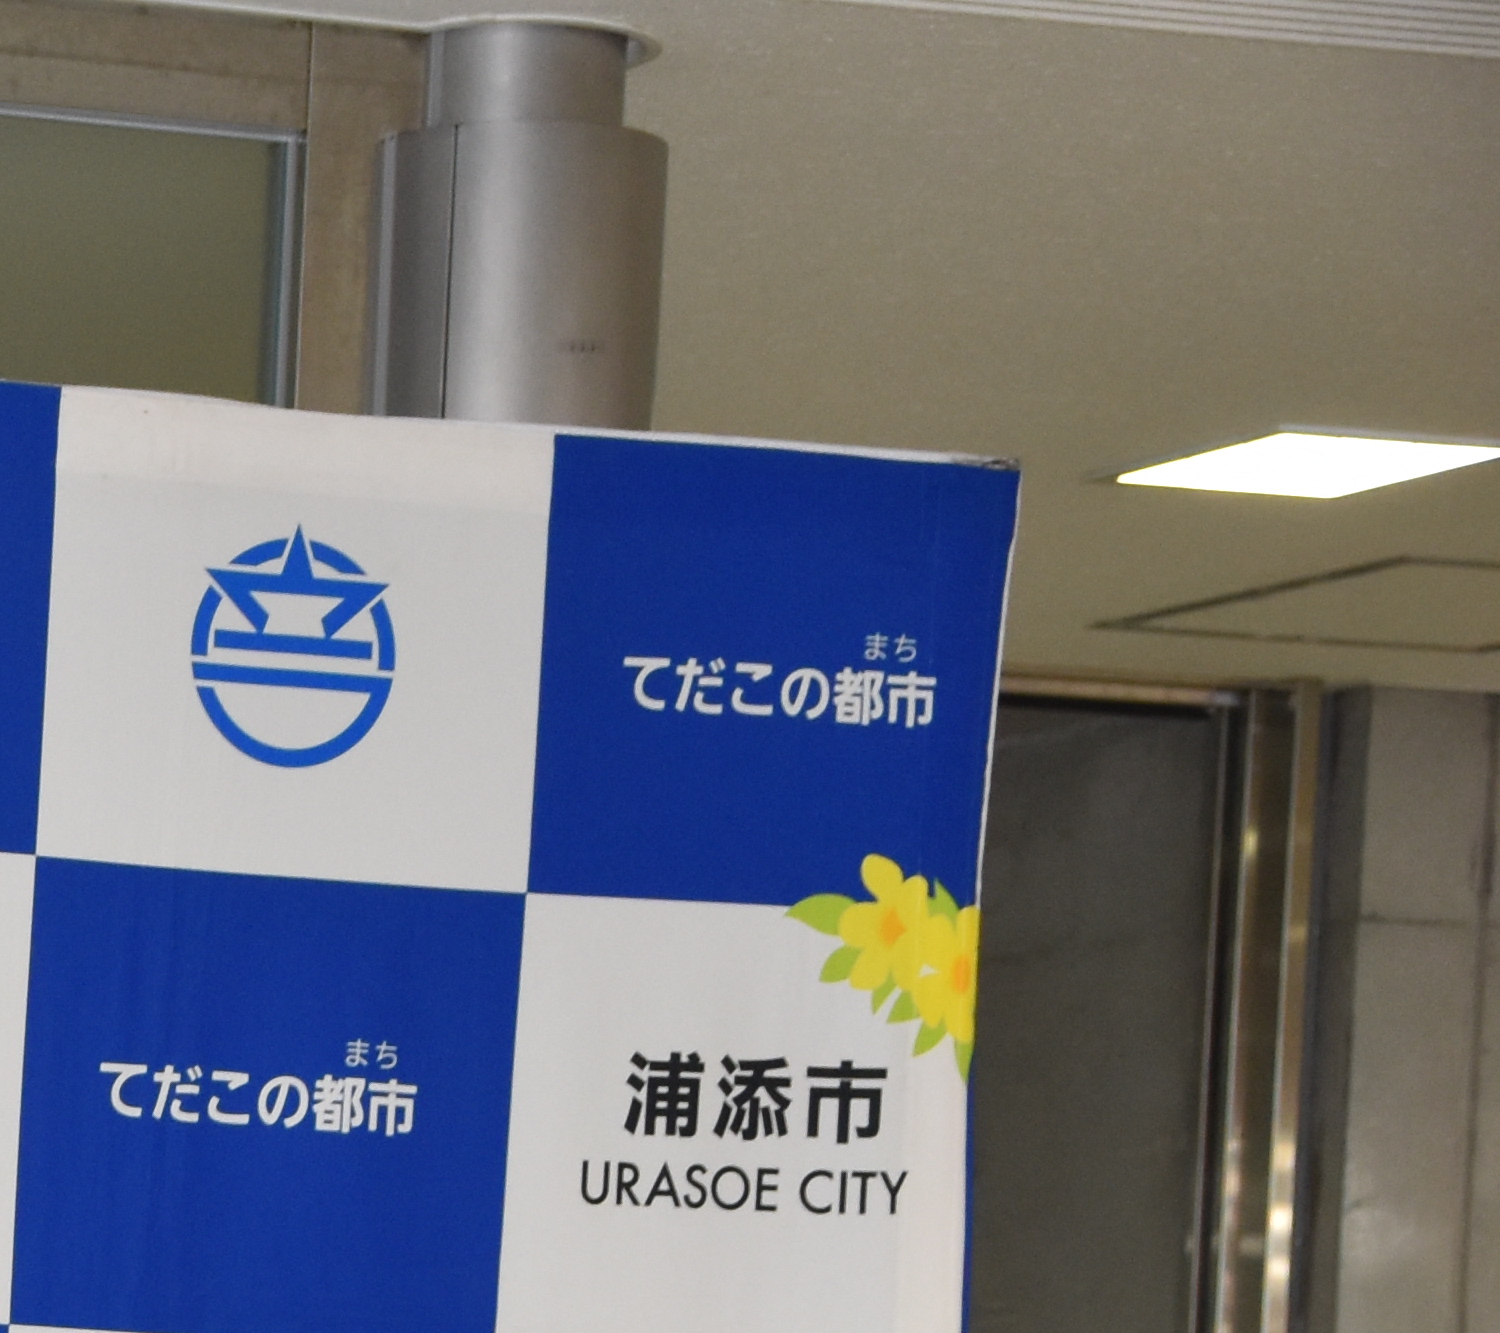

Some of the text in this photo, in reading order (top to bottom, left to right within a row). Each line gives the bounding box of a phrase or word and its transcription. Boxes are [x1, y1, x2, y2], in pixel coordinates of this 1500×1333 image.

[866, 635, 915, 661] まち
[624, 657, 936, 727] てだこの都市
[346, 1040, 396, 1068] まち
[100, 1063, 417, 1136] てだこの都市
[625, 1052, 887, 1144] 浦添市
[582, 1161, 907, 1214] URASOE CITY
